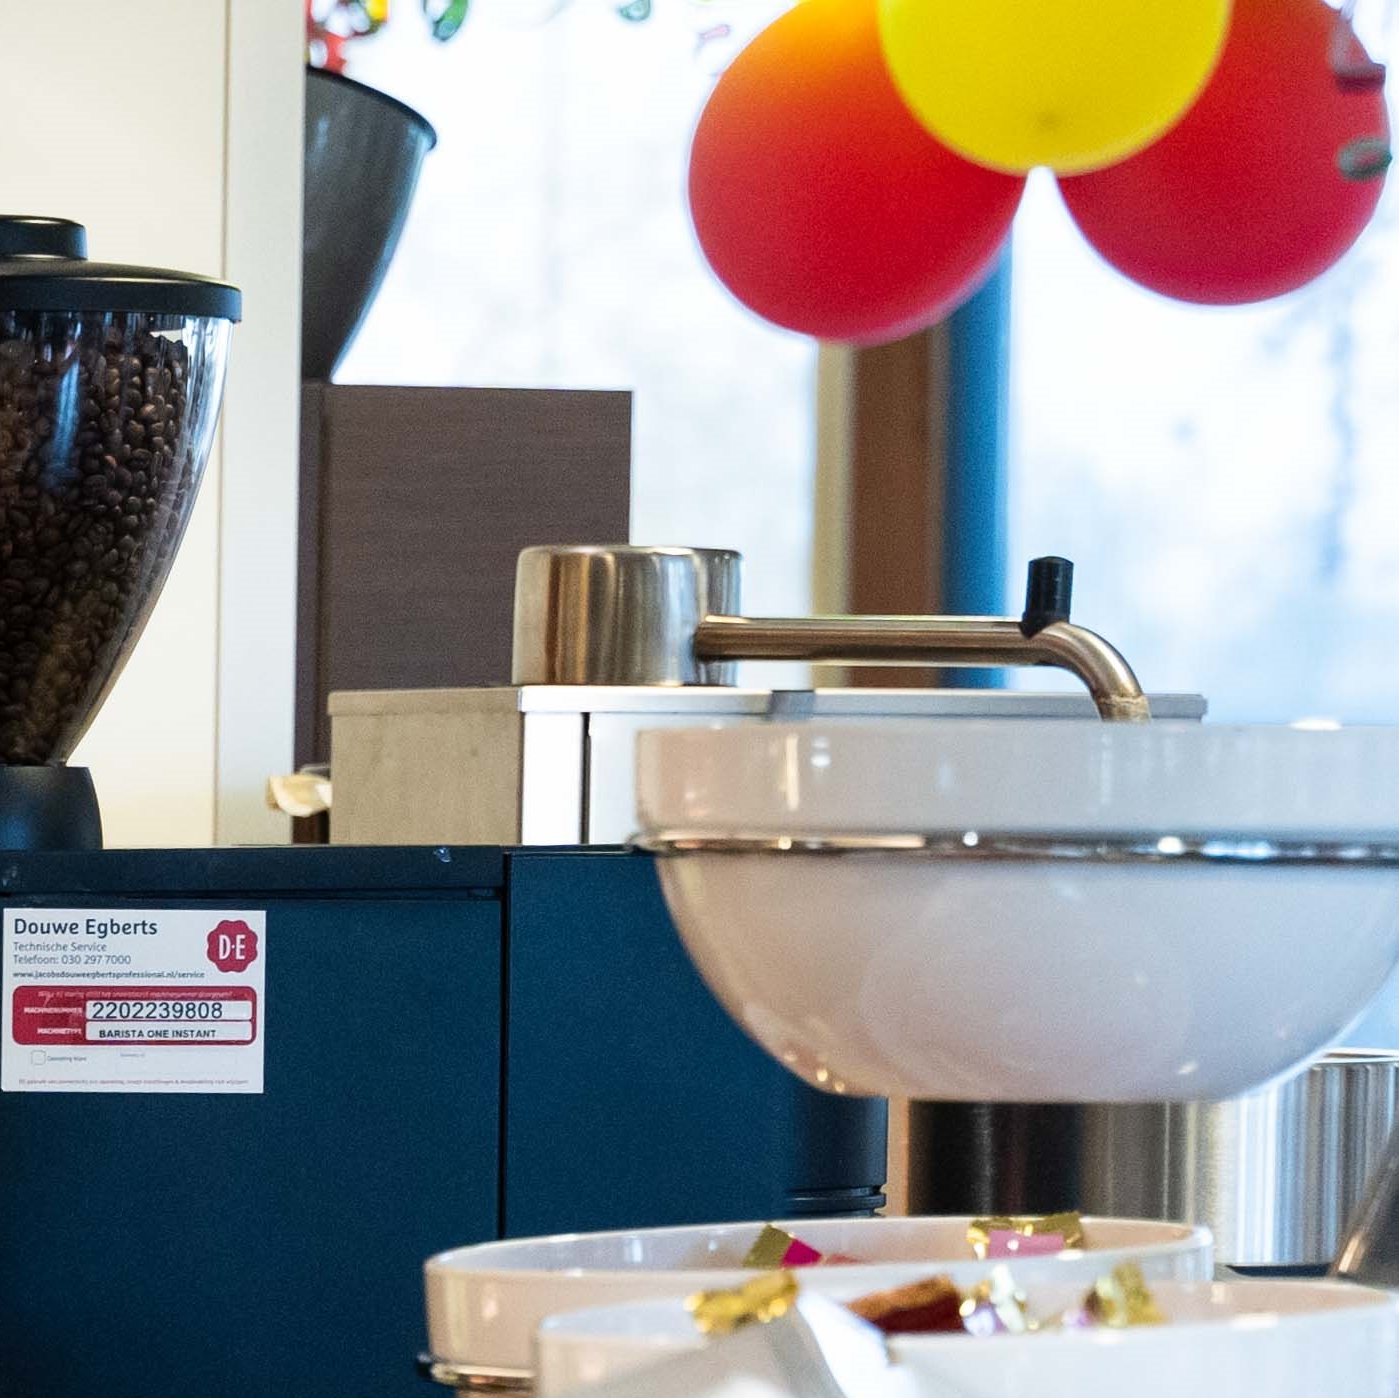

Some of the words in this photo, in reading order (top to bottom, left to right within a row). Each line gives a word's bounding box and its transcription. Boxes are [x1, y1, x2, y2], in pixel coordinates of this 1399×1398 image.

[13, 918, 79, 936] Douwe
[85, 918, 158, 938] Egberts
[13, 941, 68, 952] Technische
[70, 941, 108, 952] Service
[13, 954, 59, 965] Telefoon:
[61, 954, 82, 965] 030
[84, 954, 103, 965] 297
[104, 954, 131, 965] 7000
[92, 1002, 224, 1019] 2202239808
[98, 1029, 145, 1039] BARISTA
[146, 1029, 171, 1039] ONE
[171, 1029, 217, 1039] INSTANT
